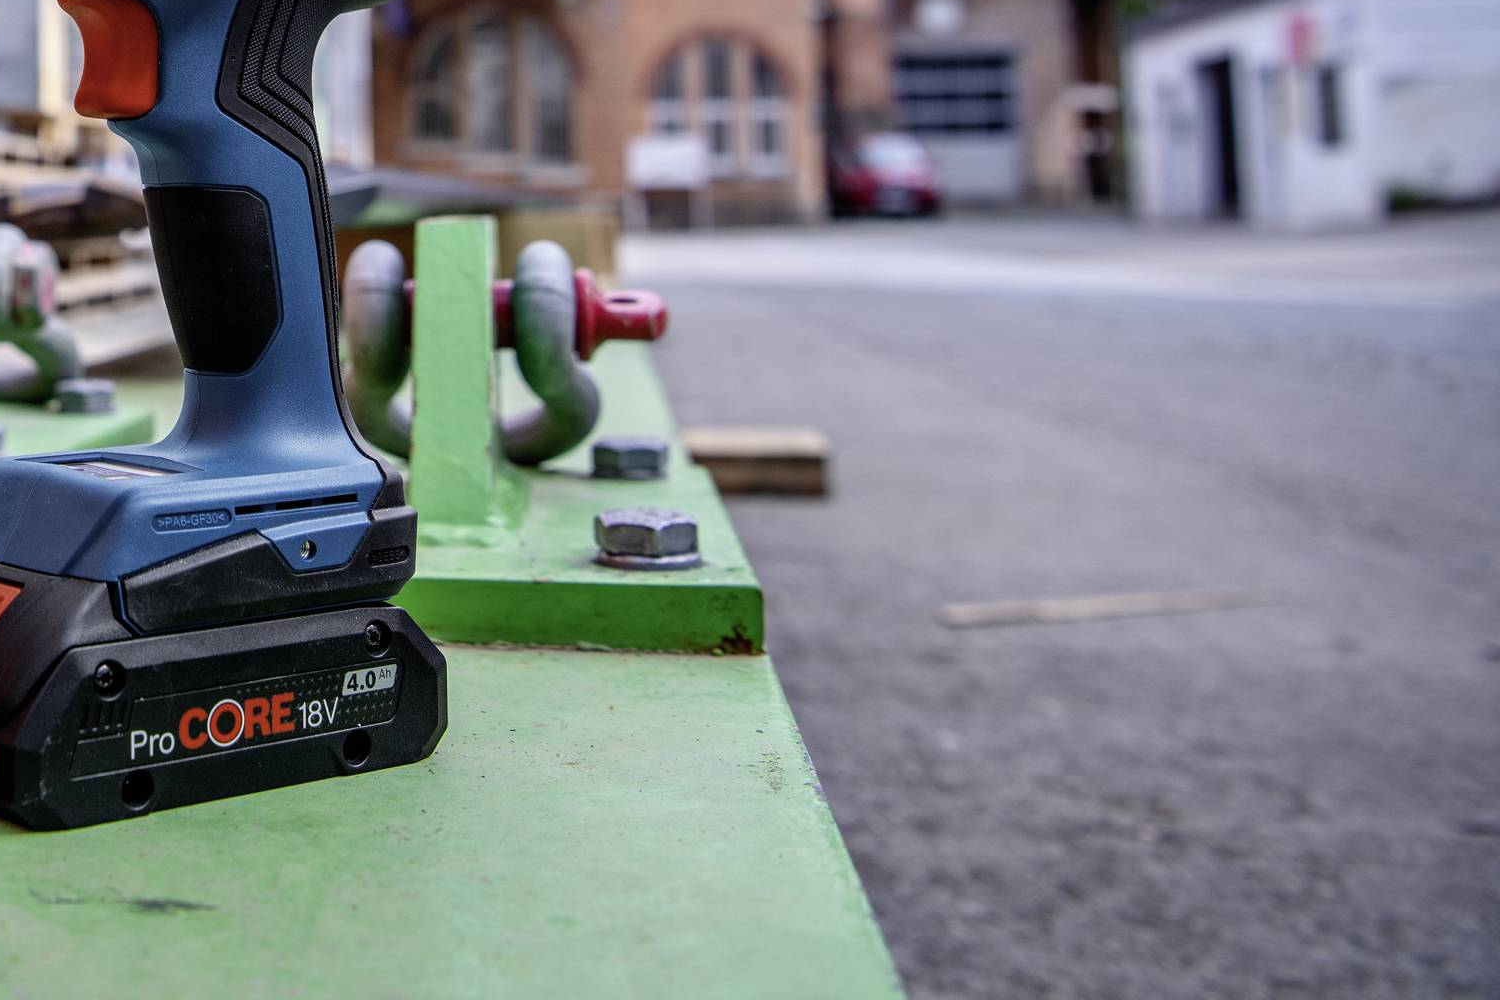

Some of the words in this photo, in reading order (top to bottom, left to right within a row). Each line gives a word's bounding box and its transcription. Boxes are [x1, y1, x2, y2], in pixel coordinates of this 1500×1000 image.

[346, 670, 377, 692] 4.0
[378, 668, 392, 681] Ah
[298, 696, 339, 729] 18V
